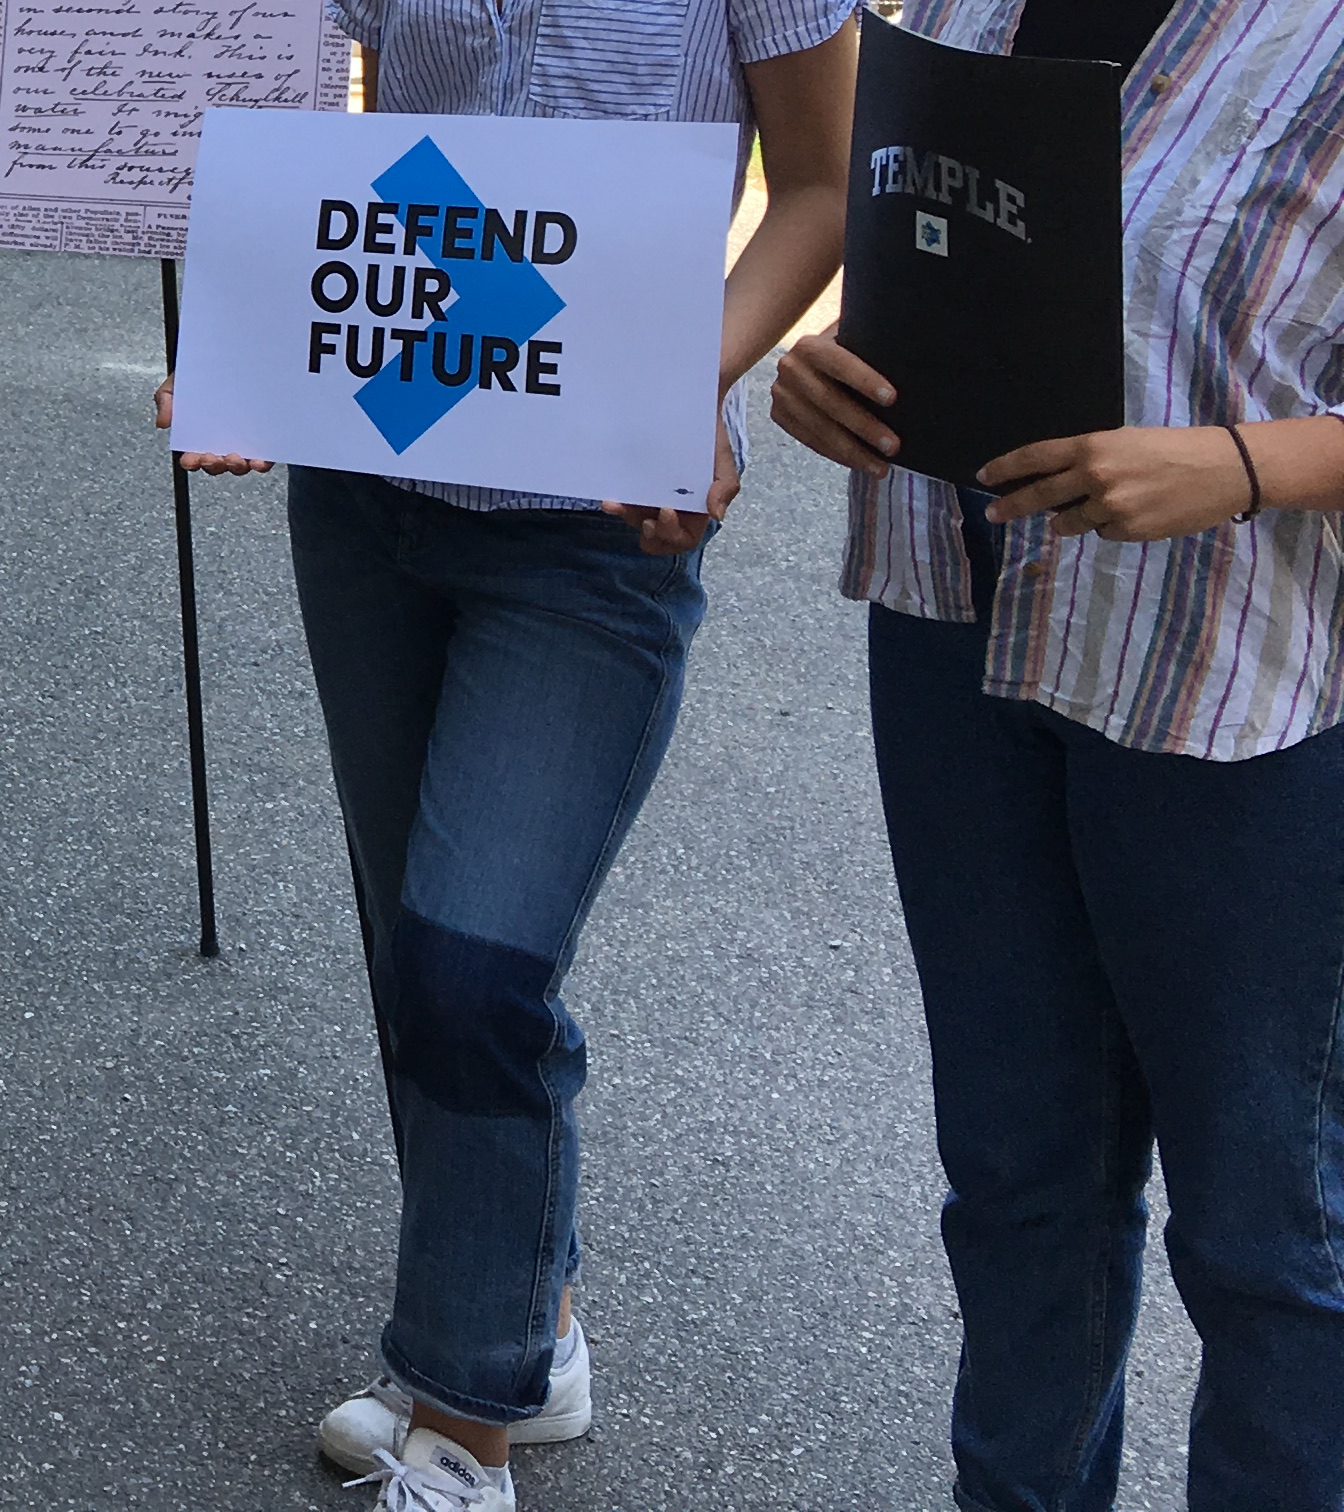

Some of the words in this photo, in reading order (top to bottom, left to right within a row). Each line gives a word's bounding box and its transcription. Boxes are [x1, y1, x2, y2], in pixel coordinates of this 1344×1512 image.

[52, 3, 141, 15] second
[153, 2, 219, 30] story
[228, 2, 252, 30] of
[213, 43, 267, 61] This
[56, 60, 79, 81] of
[83, 62, 123, 79] the
[275, 69, 300, 92] of
[68, 82, 185, 100] celebrated
[14, 101, 86, 117] water
[61, 126, 95, 137] one
[107, 120, 138, 137] to
[134, 128, 161, 146] go
[7, 137, 179, 160] manufacture
[4, 156, 58, 178] from
[869, 144, 1028, 243] TEMPLE
[315, 197, 579, 266] DEFEND
[310, 259, 452, 322] OUR
[307, 320, 564, 397] FUTURE
[439, 1456, 476, 1487] adidas
